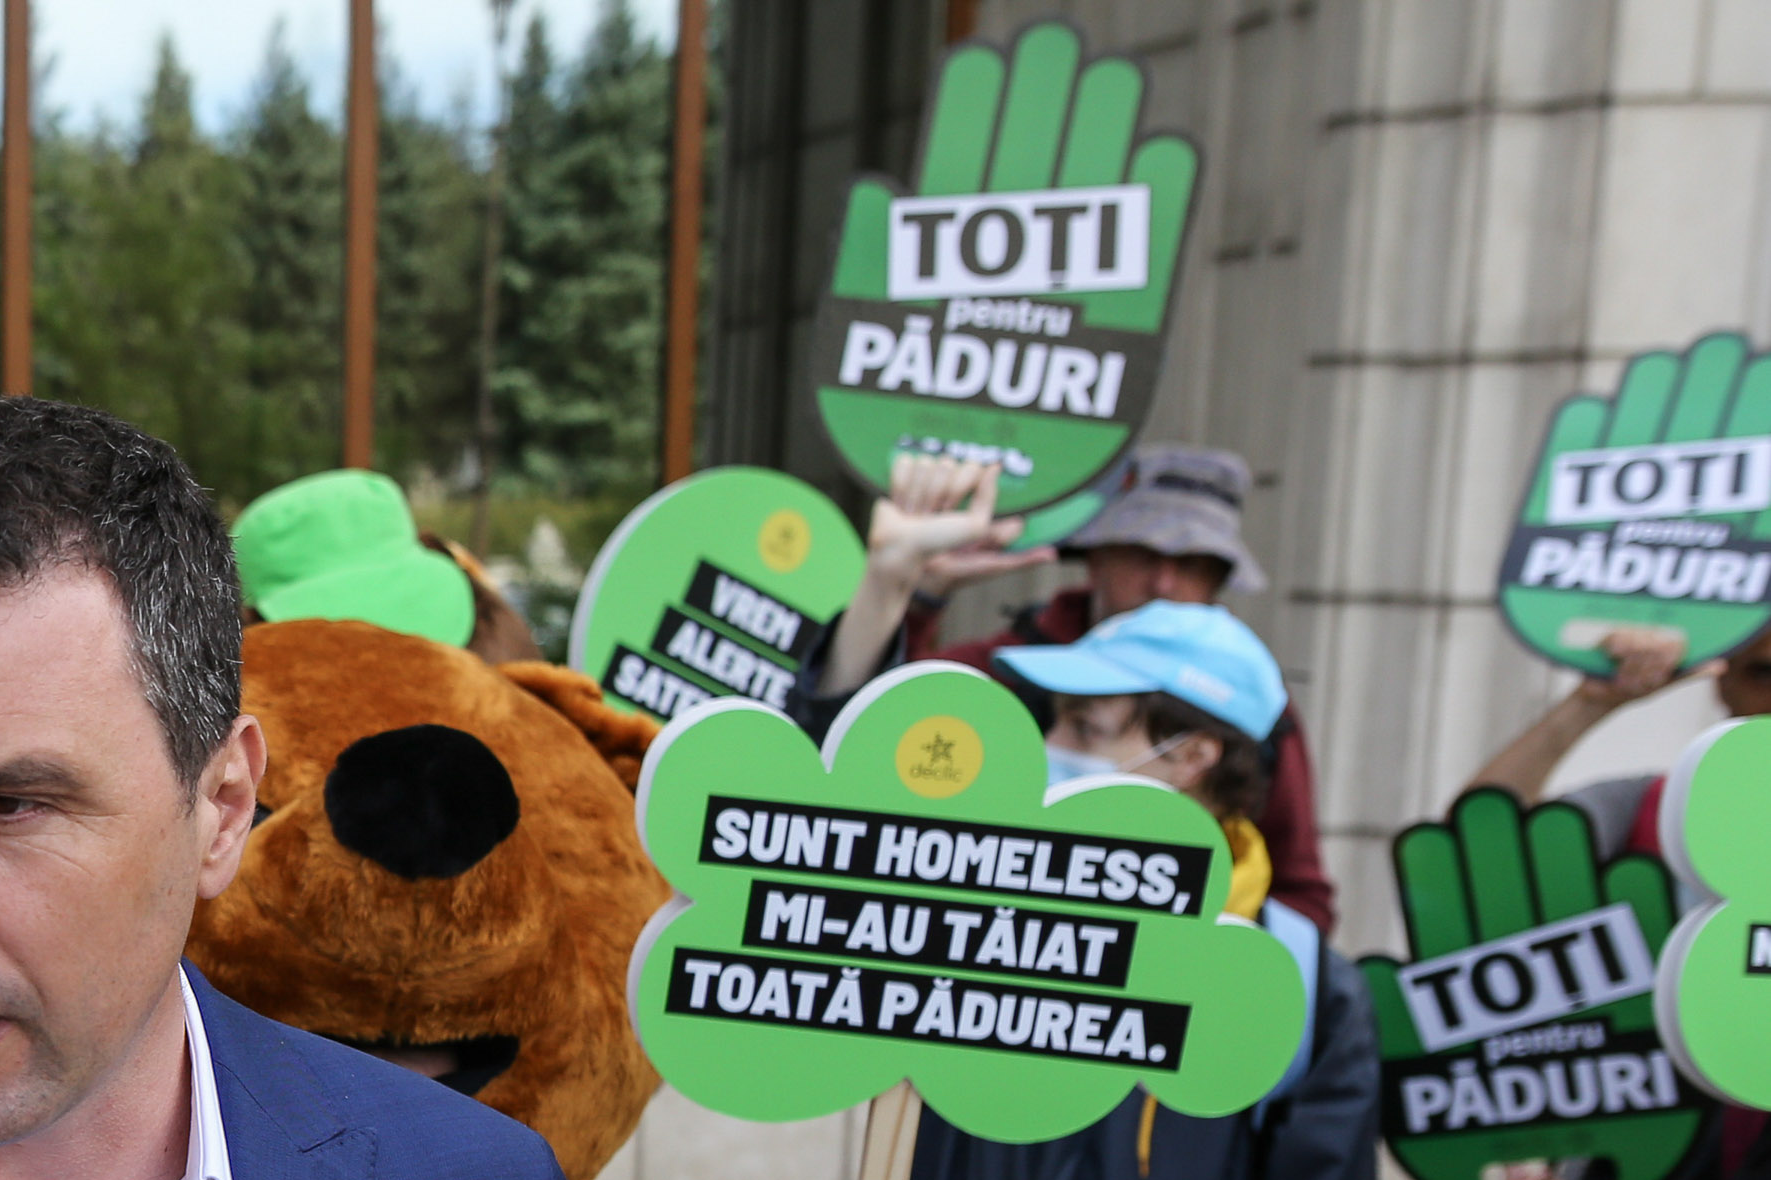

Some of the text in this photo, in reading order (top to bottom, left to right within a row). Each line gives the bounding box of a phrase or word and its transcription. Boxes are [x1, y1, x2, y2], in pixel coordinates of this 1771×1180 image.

[944, 297, 1073, 337] pentru
[840, 315, 1126, 418] PĂDURI
[710, 574, 802, 652] VREM
[667, 619, 797, 710] ALERTE
[712, 807, 1191, 915] SUNT HOMELESS,
[760, 890, 1119, 978] MI-AU TĂIAT
[684, 957, 1168, 1064] TOATĂ PĂDUREA.
[1484, 1020, 1605, 1065] pentru
[1400, 1051, 1680, 1134] PĂDURI
